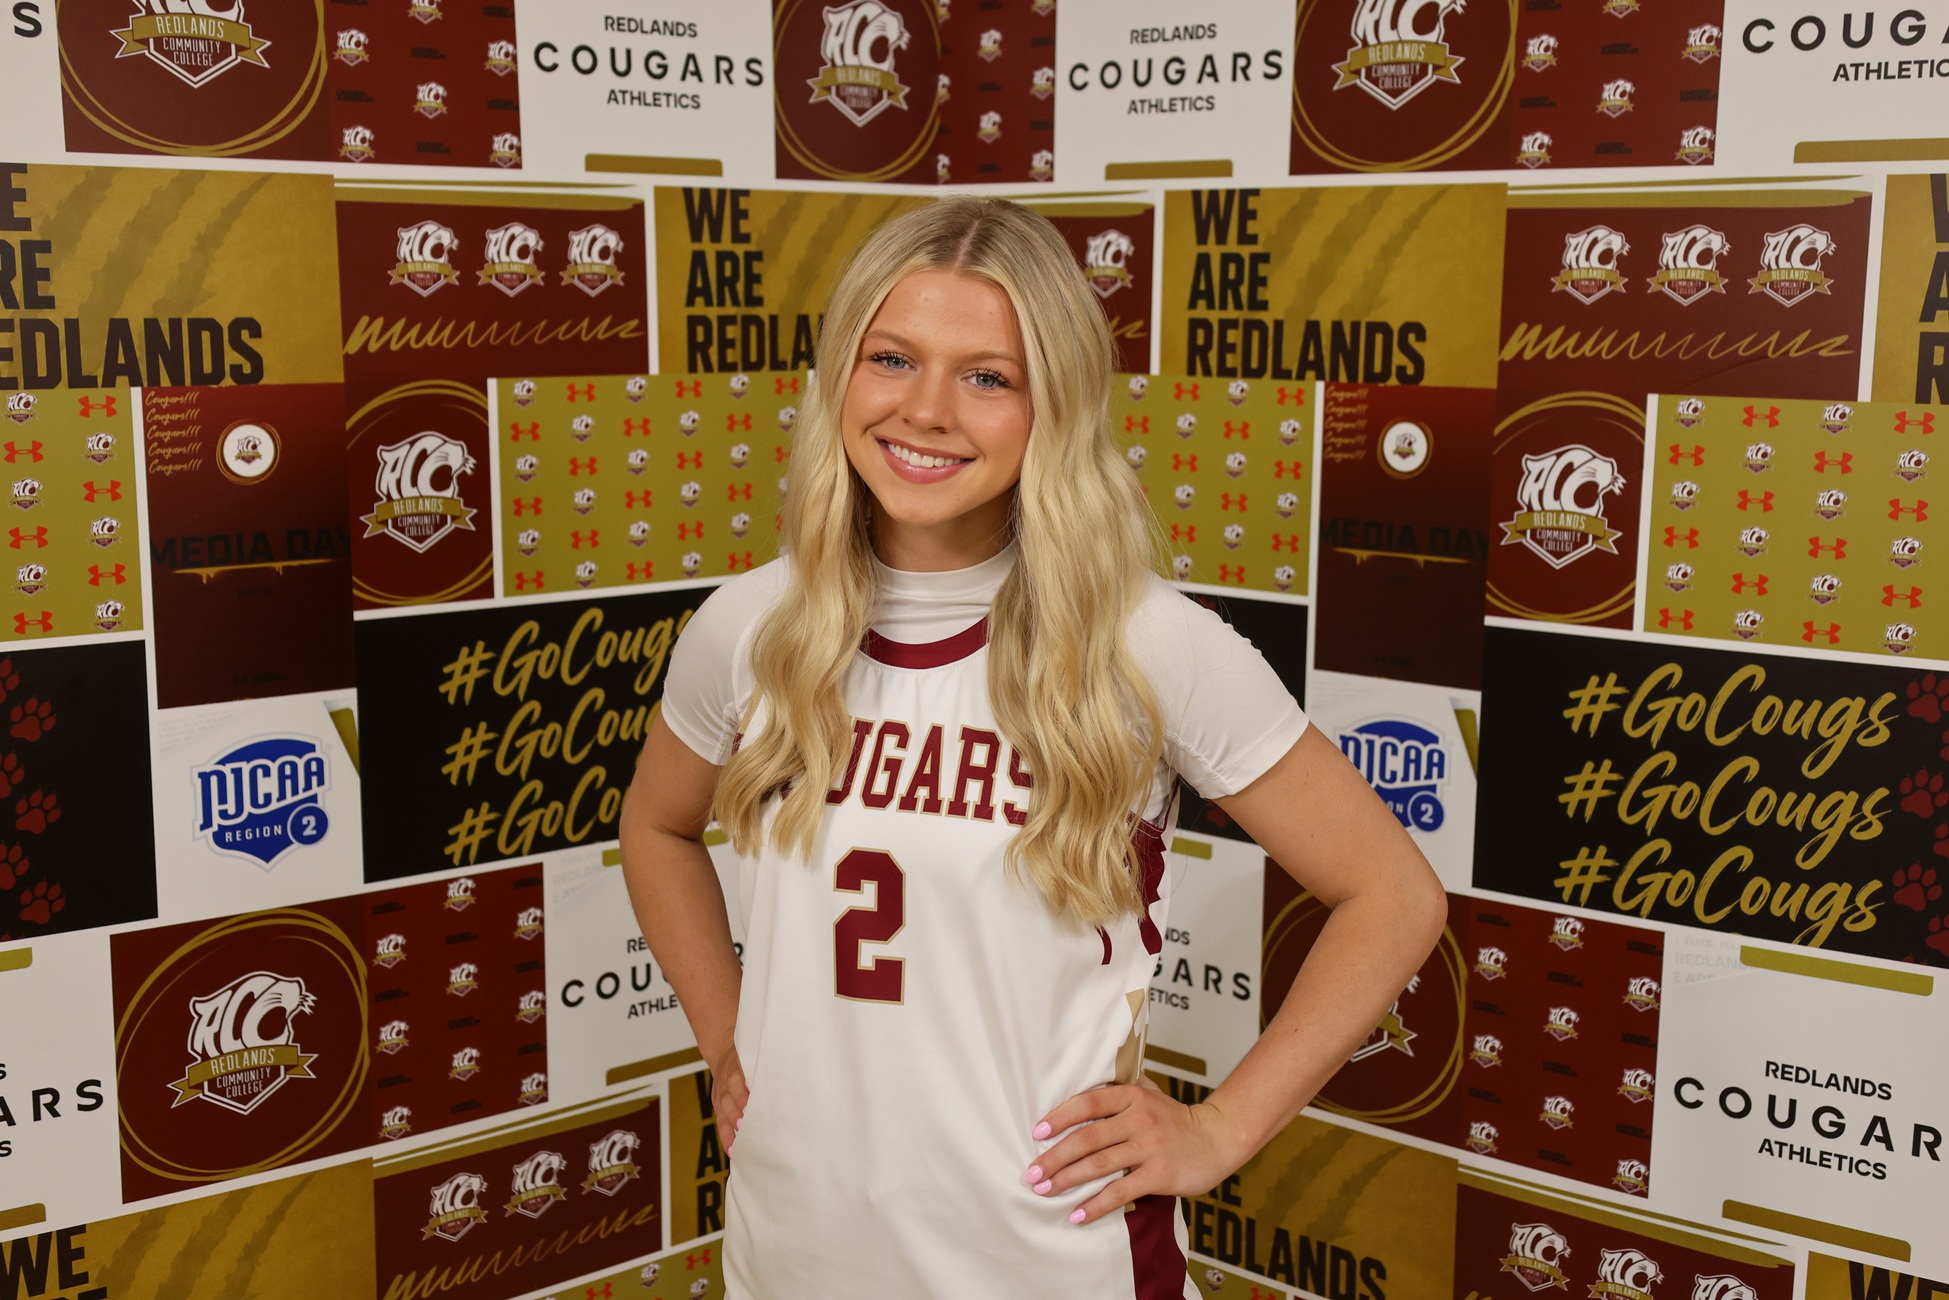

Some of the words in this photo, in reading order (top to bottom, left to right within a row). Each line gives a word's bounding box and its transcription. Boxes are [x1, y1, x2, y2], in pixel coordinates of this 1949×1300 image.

[155, 15, 225, 39] REDLANDS
[604, 15, 698, 38] REDLANDS
[1129, 23, 1217, 45] REDLANDS
[1743, 9, 1949, 54] COUG
[162, 37, 221, 54] COMMUNITY
[1368, 44, 1426, 63] REDLANDS
[173, 51, 214, 67] COLLEGE
[533, 41, 764, 87] COUGARS
[1068, 49, 1283, 91] COUGARS
[1371, 62, 1421, 78] COMMUNITY
[835, 67, 882, 86] REDLANDS
[1378, 76, 1413, 90] COLLEGE
[606, 88, 701, 110] ATHLETICS
[1127, 95, 1216, 115] ATHLETICS
[682, 186, 752, 244] WE
[1192, 188, 1260, 246] WE
[685, 250, 764, 308] ARE
[1188, 252, 1271, 311] ARE
[1571, 268, 1606, 280] REDLANDS
[1669, 268, 1706, 281] REDLANDS
[1771, 268, 1810, 281] REDLANDS
[687, 314, 825, 374] REDLA
[1187, 317, 1427, 386] REDLANDS
[393, 497, 444, 515] REDLANDS
[397, 513, 441, 527] COMMUNITY
[404, 524, 435, 537] COLLEGE
[1532, 512, 1587, 530] REDLANDS
[1320, 518, 1419, 552] MEDIA
[1536, 528, 1582, 543] COMMUNITY
[1542, 540, 1575, 553] COLLEGE
[150, 532, 275, 569] MEDIA
[1562, 662, 1899, 779] #GoCougs
[441, 687, 662, 787] #GoCou
[197, 756, 326, 832] NJCAA
[1420, 802, 1434, 824] 2
[1558, 750, 1892, 870] #GoCougs
[225, 824, 283, 843] REGION
[301, 814, 318, 837] 2
[1553, 837, 1886, 949] #GoCougs
[833, 846, 906, 1005] 2
[210, 1048, 276, 1077] REDLANDS
[216, 1067, 272, 1090] COMMUNITY
[1765, 1060, 1893, 1101] REDLANDS
[226, 1081, 265, 1100] COLLEGE
[1757, 1138, 1888, 1181] ATHLETICS
